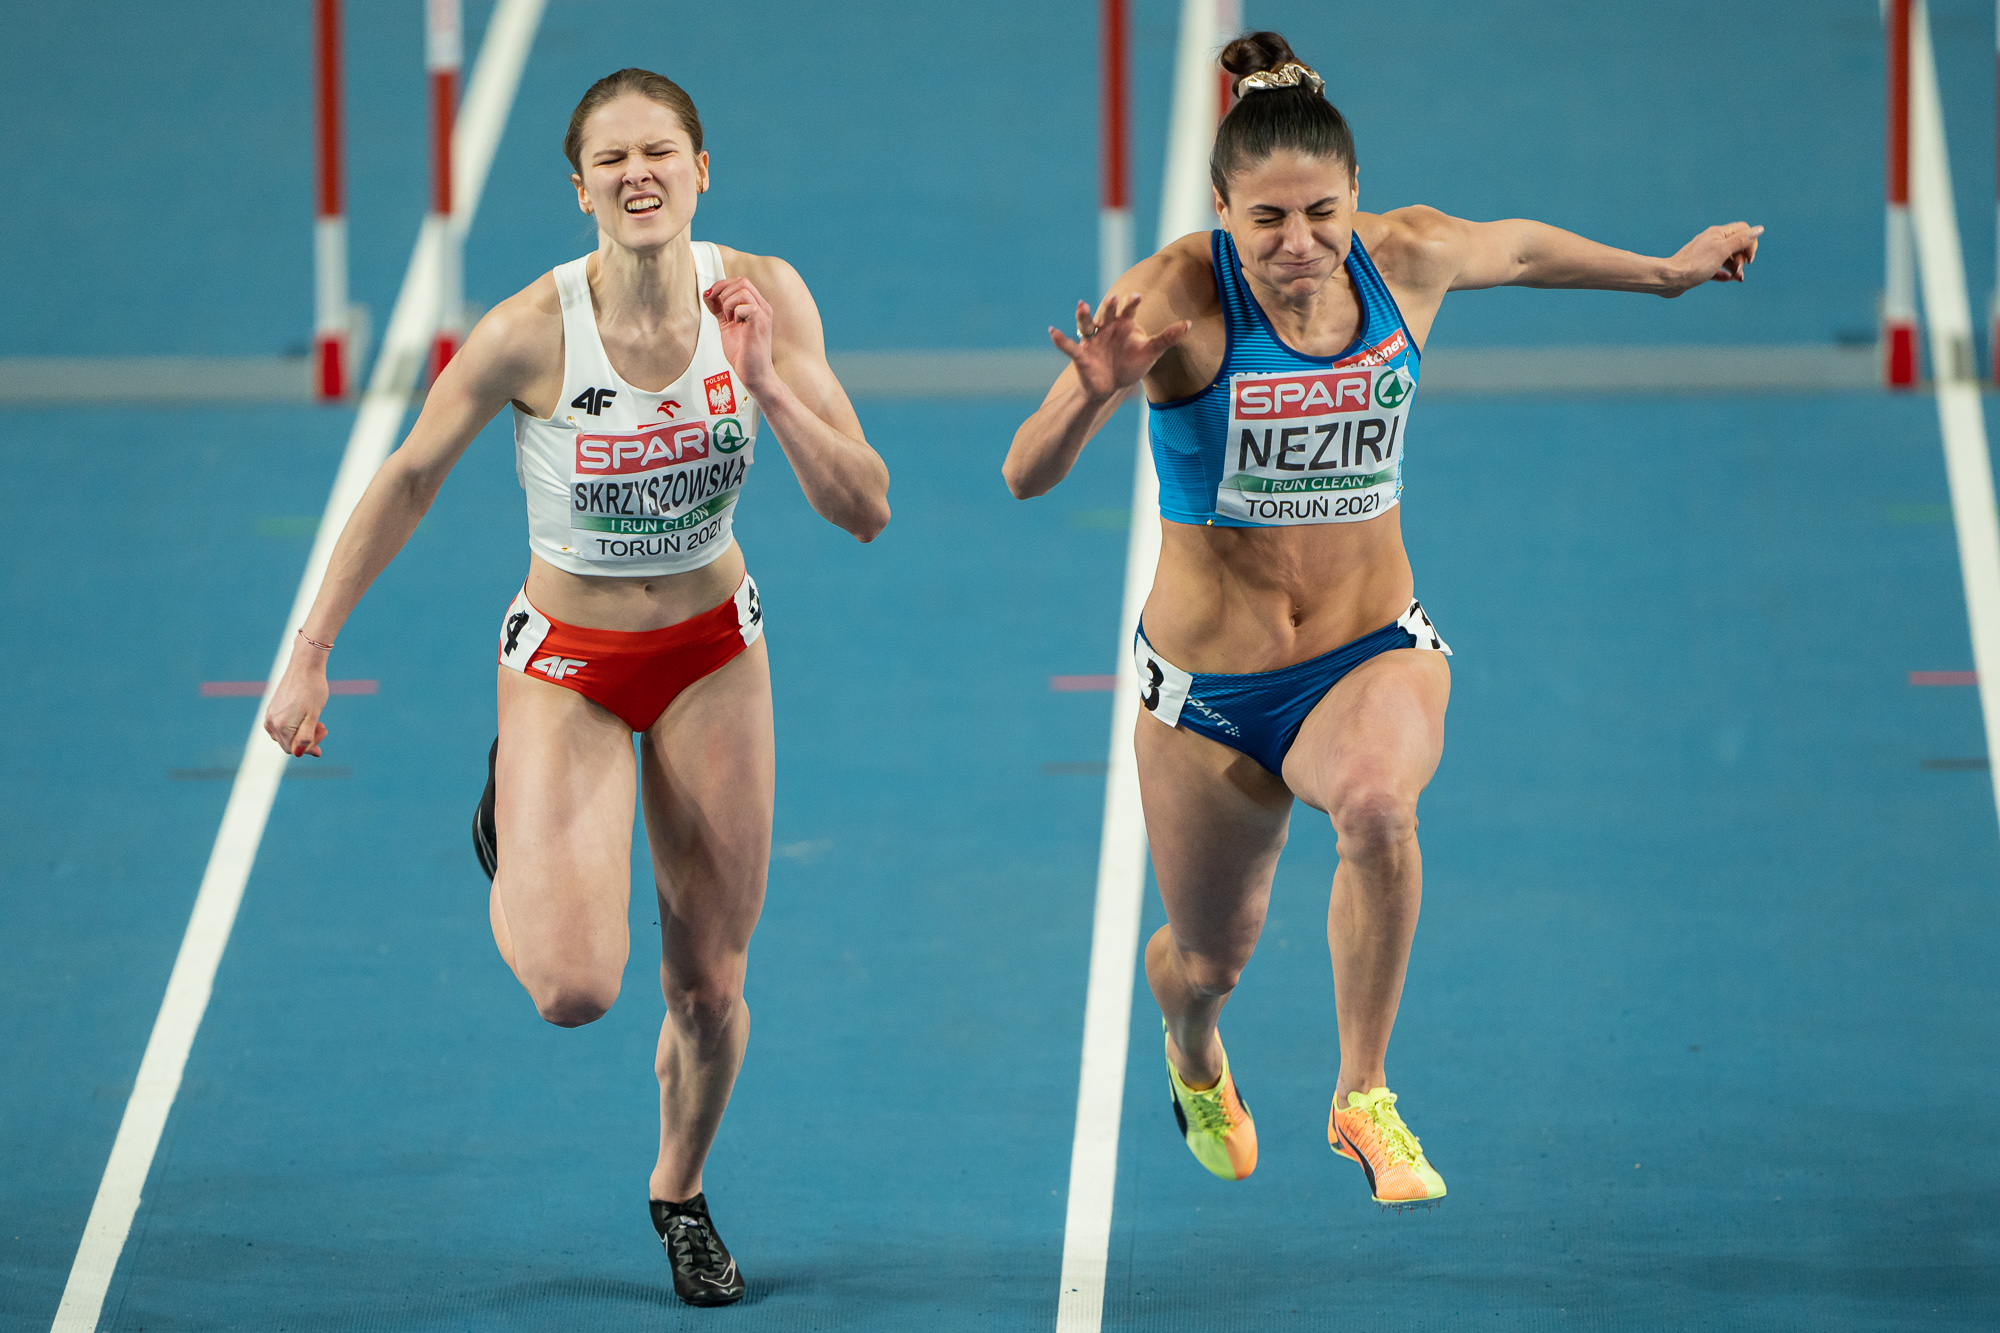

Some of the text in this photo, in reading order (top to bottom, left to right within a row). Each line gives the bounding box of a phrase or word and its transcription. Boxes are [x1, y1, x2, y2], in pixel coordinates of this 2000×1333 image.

[705, 373, 729, 386] POLSKA
[1240, 377, 1367, 414] SPAR
[571, 386, 617, 416] 4F
[579, 427, 705, 470] SPAR
[1238, 415, 1399, 471] NEZIRI
[574, 455, 746, 516] SKRZYSZOWSKA
[1262, 479, 1267, 491] I
[1271, 479, 1306, 492] RUN
[1245, 492, 1380, 519] TORUŃ 2021
[596, 516, 722, 557] TORUŃ 2021
[611, 519, 616, 532] I
[620, 519, 657, 533] RUN
[504, 610, 529, 657] 4
[531, 655, 588, 680] 4F
[1141, 657, 1164, 712] 3
[1186, 694, 1232, 727] RAFT
